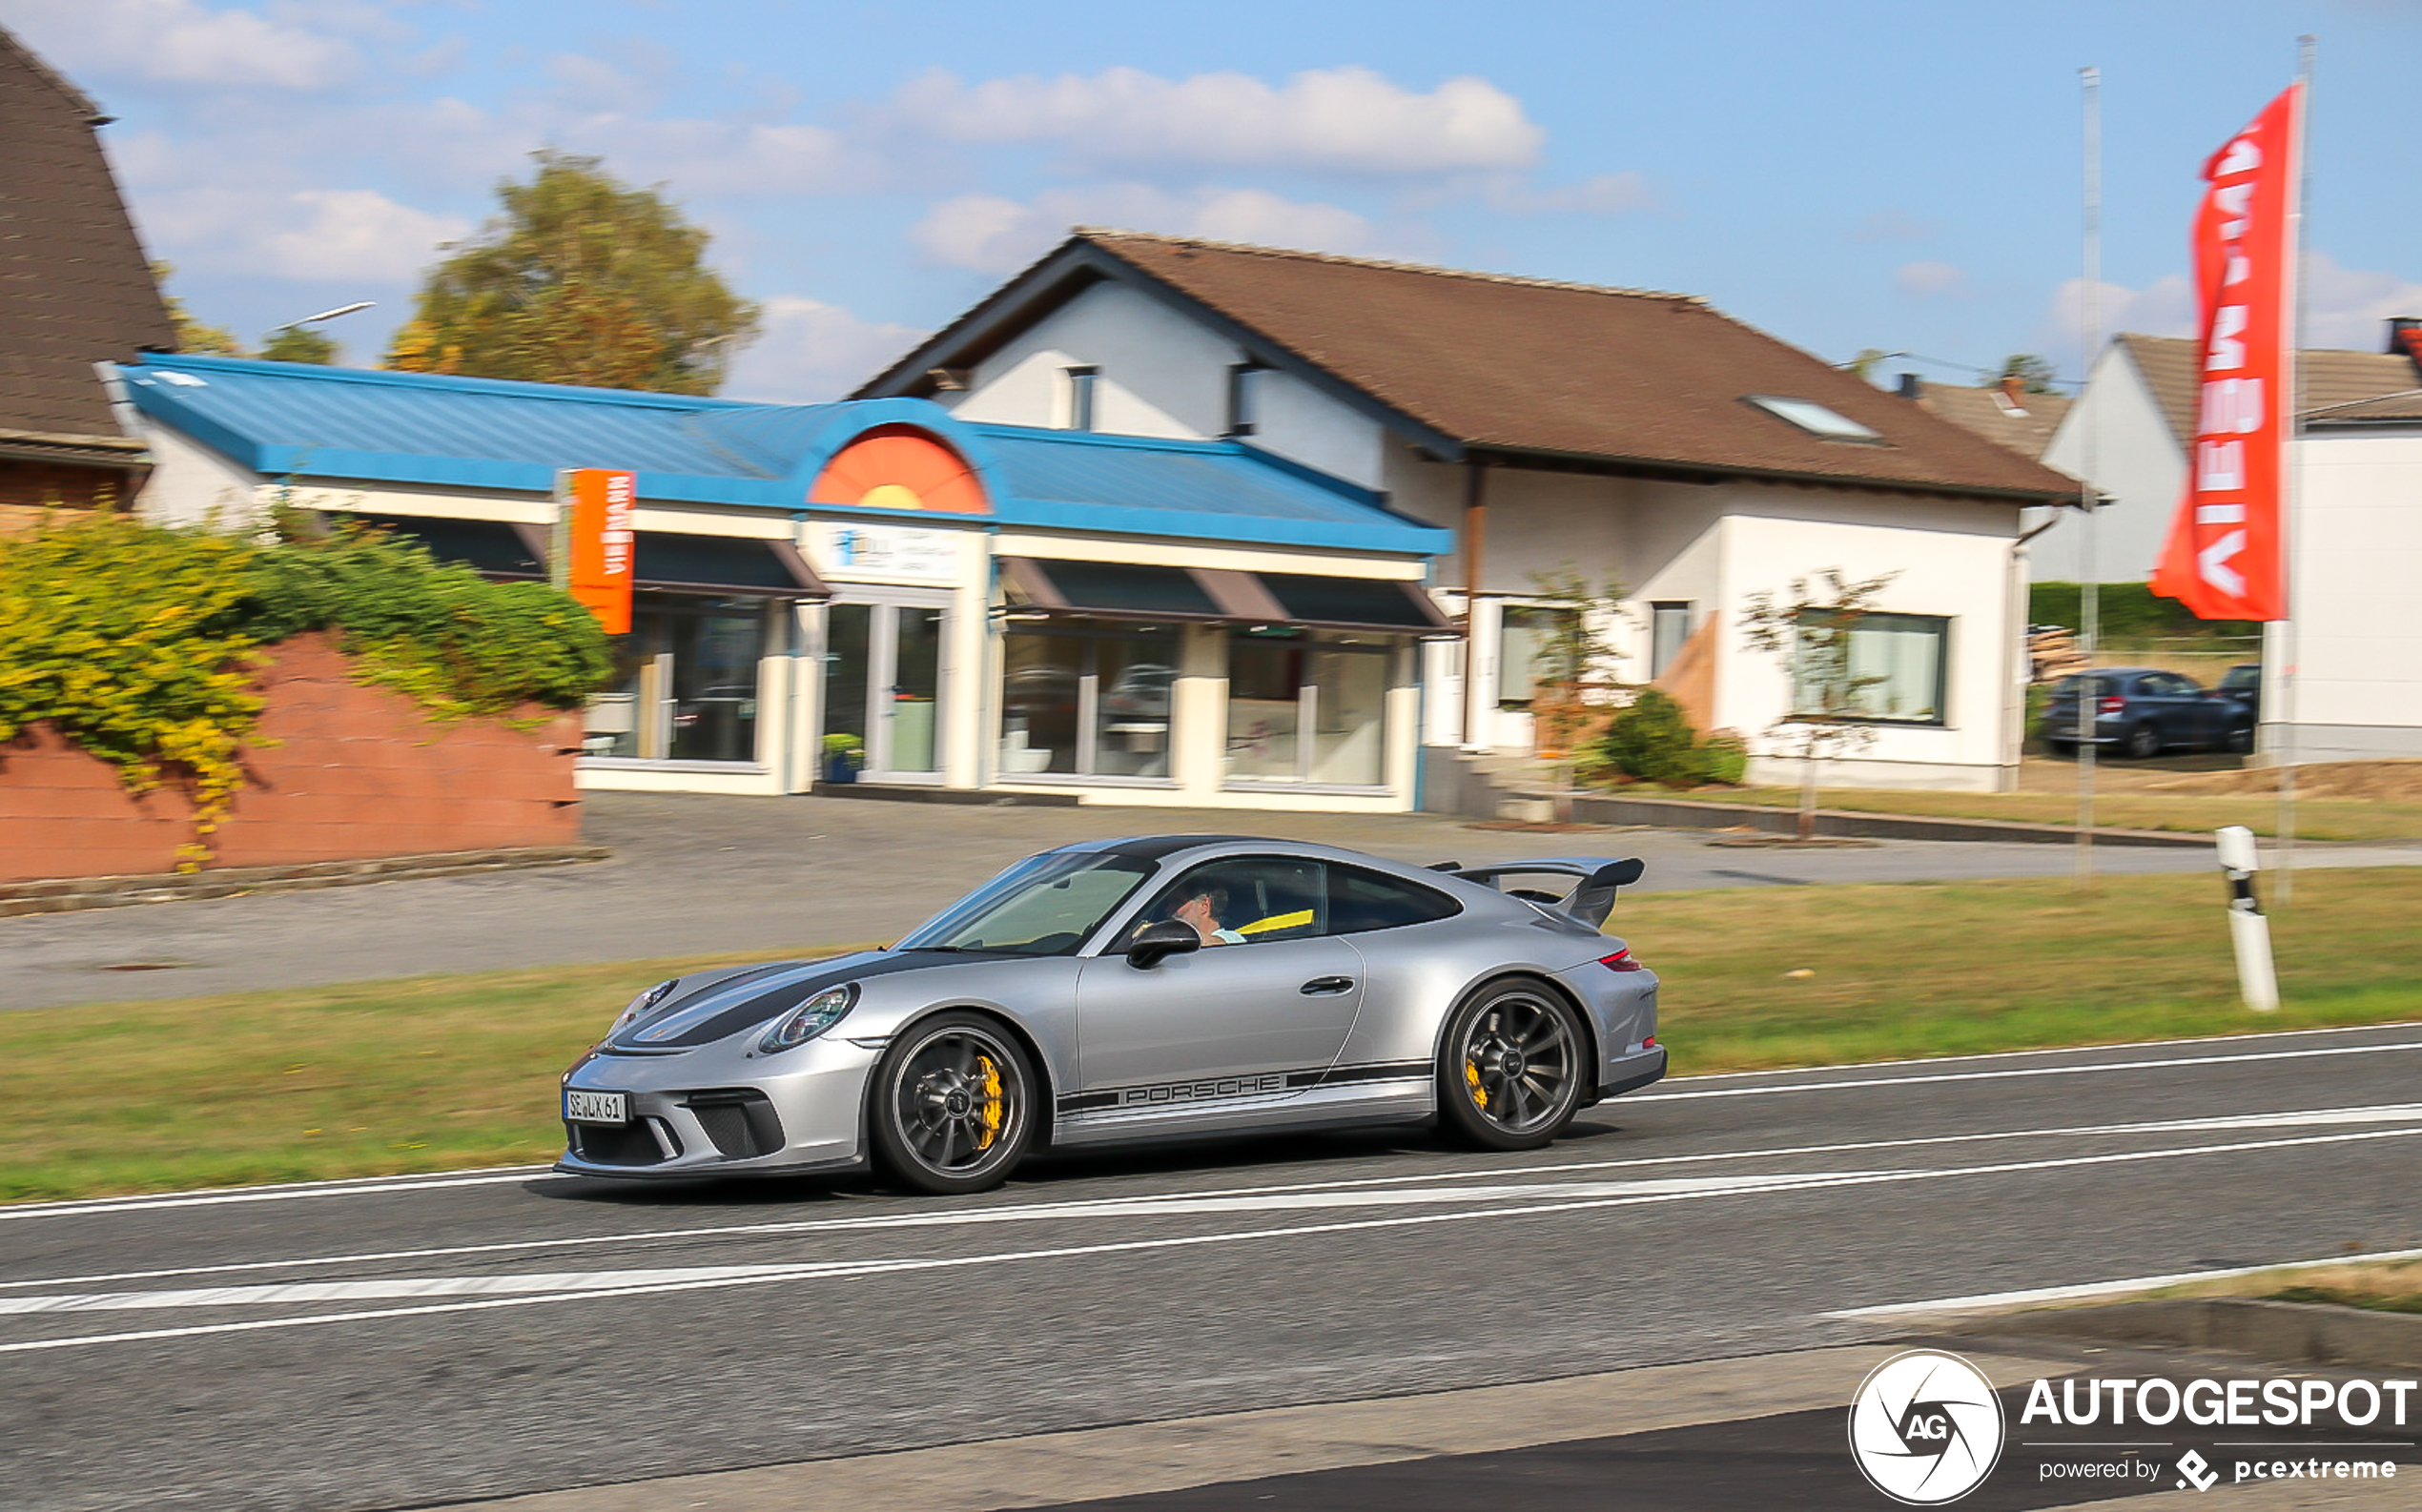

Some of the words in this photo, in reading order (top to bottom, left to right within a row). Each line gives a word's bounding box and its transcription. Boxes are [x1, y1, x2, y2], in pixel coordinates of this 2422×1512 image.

[1126, 1075, 1281, 1104] PORSCHE
[569, 1093, 582, 1116] SE
[586, 1094, 604, 1118] LX
[605, 1096, 621, 1118] 61
